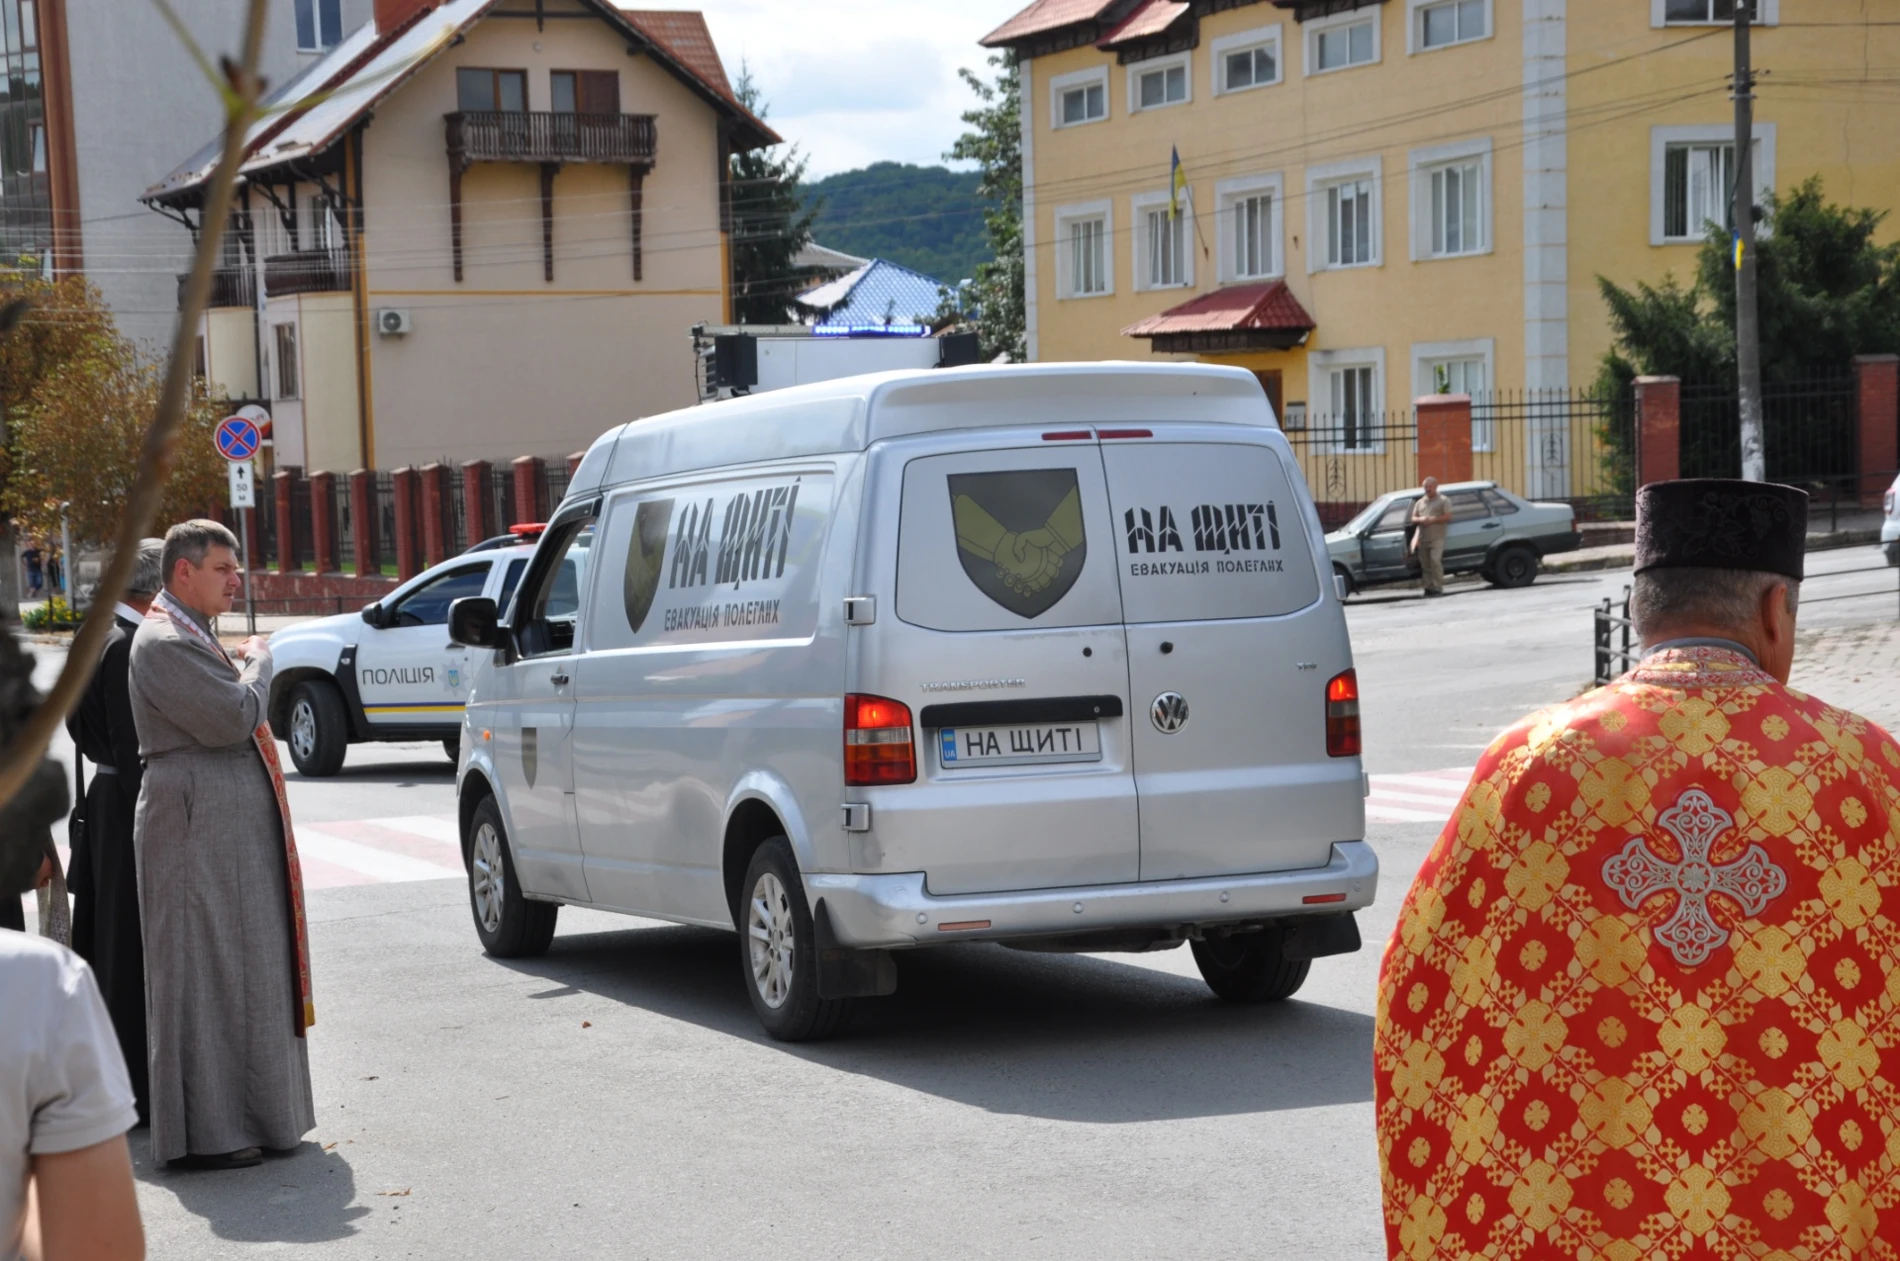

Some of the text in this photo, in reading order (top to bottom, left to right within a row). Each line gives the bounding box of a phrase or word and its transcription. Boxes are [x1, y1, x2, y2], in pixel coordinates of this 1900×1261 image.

[236, 483, 247, 491] 50
[1124, 500, 1281, 555] НА ЩИТІ
[669, 498, 714, 589] НА
[362, 667, 434, 685] ПОЛІЦІЯ
[920, 678, 1026, 692] TRANSPORTER
[965, 728, 1082, 756] НА ЩИТІ
[944, 750, 956, 758] UA
